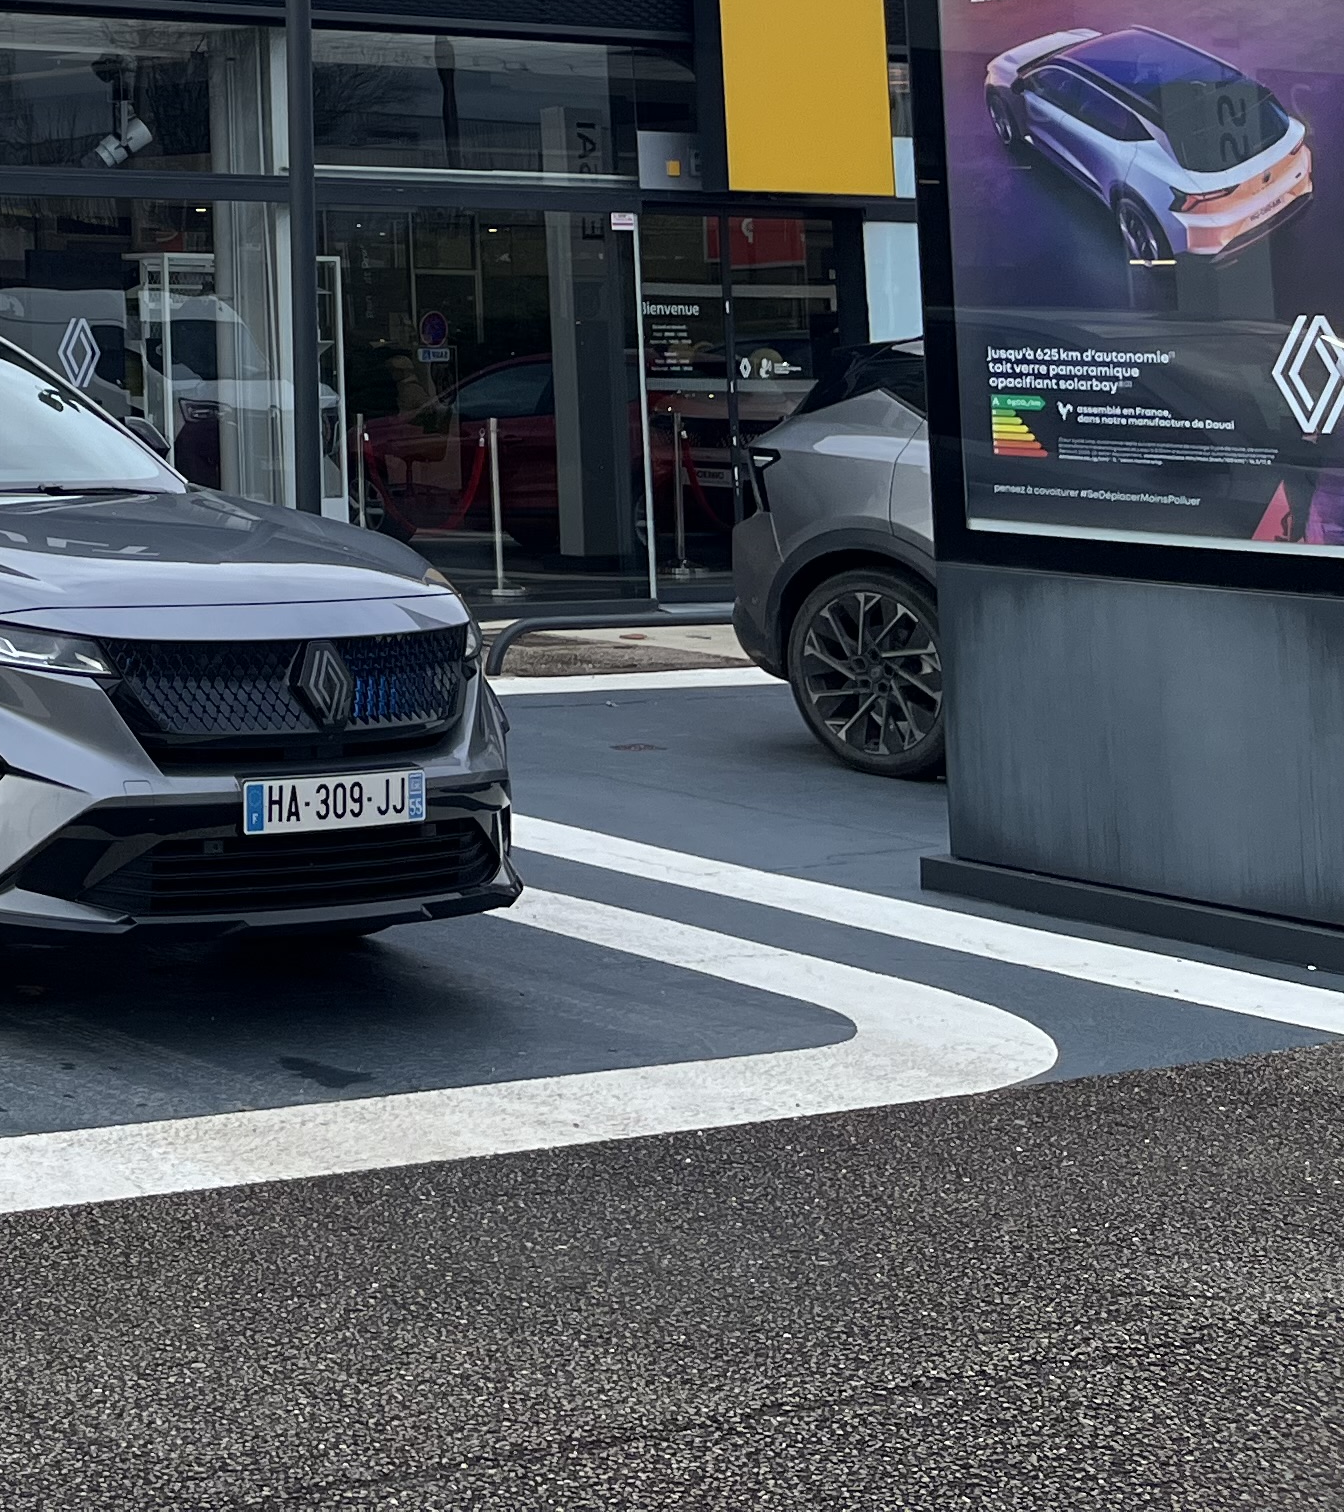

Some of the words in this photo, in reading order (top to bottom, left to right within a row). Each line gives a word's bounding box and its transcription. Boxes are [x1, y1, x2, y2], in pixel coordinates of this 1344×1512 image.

[1036, 348, 1059, 361] 625
[1059, 348, 1081, 361] km
[988, 361, 1013, 373] toit
[1013, 364, 1047, 375] verre
[1049, 364, 1140, 380] panoramique
[989, 376, 1057, 390] opacifiant
[992, 397, 1000, 406] A
[1077, 405, 1121, 415] assemblé
[1122, 408, 1135, 416] en
[1077, 414, 1100, 424] dans
[1101, 416, 1126, 425] notre
[1128, 418, 1190, 429] manufacture
[1192, 419, 1204, 429] de
[1205, 420, 1234, 430] Douai
[1034, 486, 1079, 498] covoiturer
[251, 812, 259, 824] F
[267, 777, 406, 823] HA-309-JJ
[409, 798, 423, 816] 55
